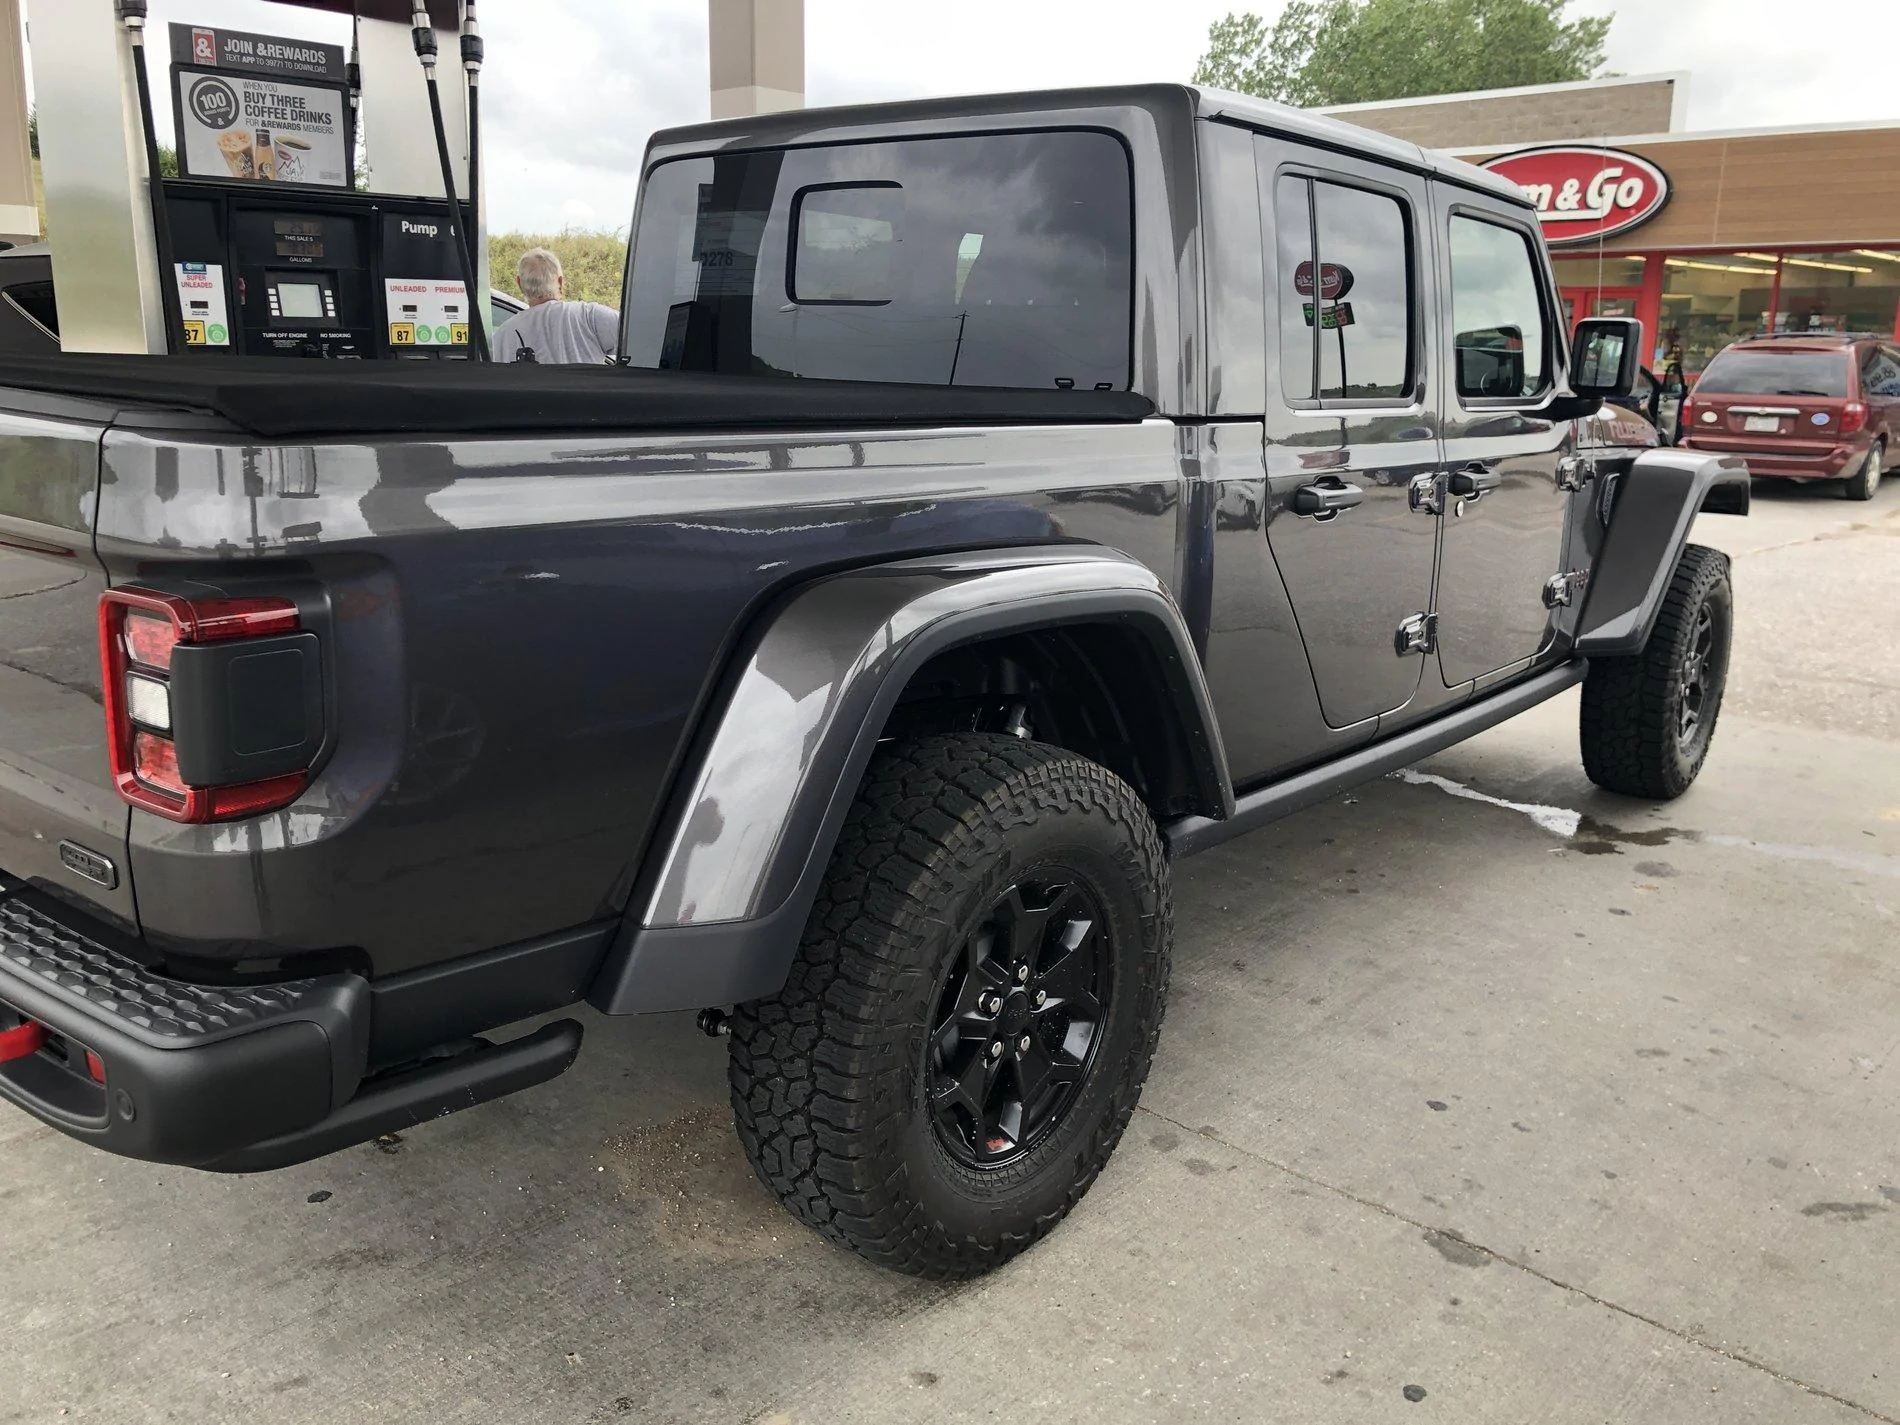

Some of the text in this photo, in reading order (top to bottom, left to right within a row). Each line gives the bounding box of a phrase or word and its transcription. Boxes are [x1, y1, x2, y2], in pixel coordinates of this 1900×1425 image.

[224, 39, 327, 64] JOIN &REWARDS
[225, 53, 240, 62] TEXT
[242, 56, 255, 64] APP
[256, 57, 264, 66] TO
[285, 61, 293, 69] TO
[294, 62, 327, 74] DOWNLOAD
[243, 81, 278, 93] WHEN YOU
[200, 92, 227, 110] 100
[243, 91, 306, 109] BUY THREE
[244, 104, 332, 125] COFFEE DRINKS
[245, 118, 334, 135] FOR &REWARDS MEMBERS
[1555, 178, 1582, 211] &
[1586, 167, 1644, 216] Go
[401, 220, 438, 238] Pump
[185, 329, 199, 341] 87
[396, 331, 409, 342] 87
[456, 331, 467, 341] 91
